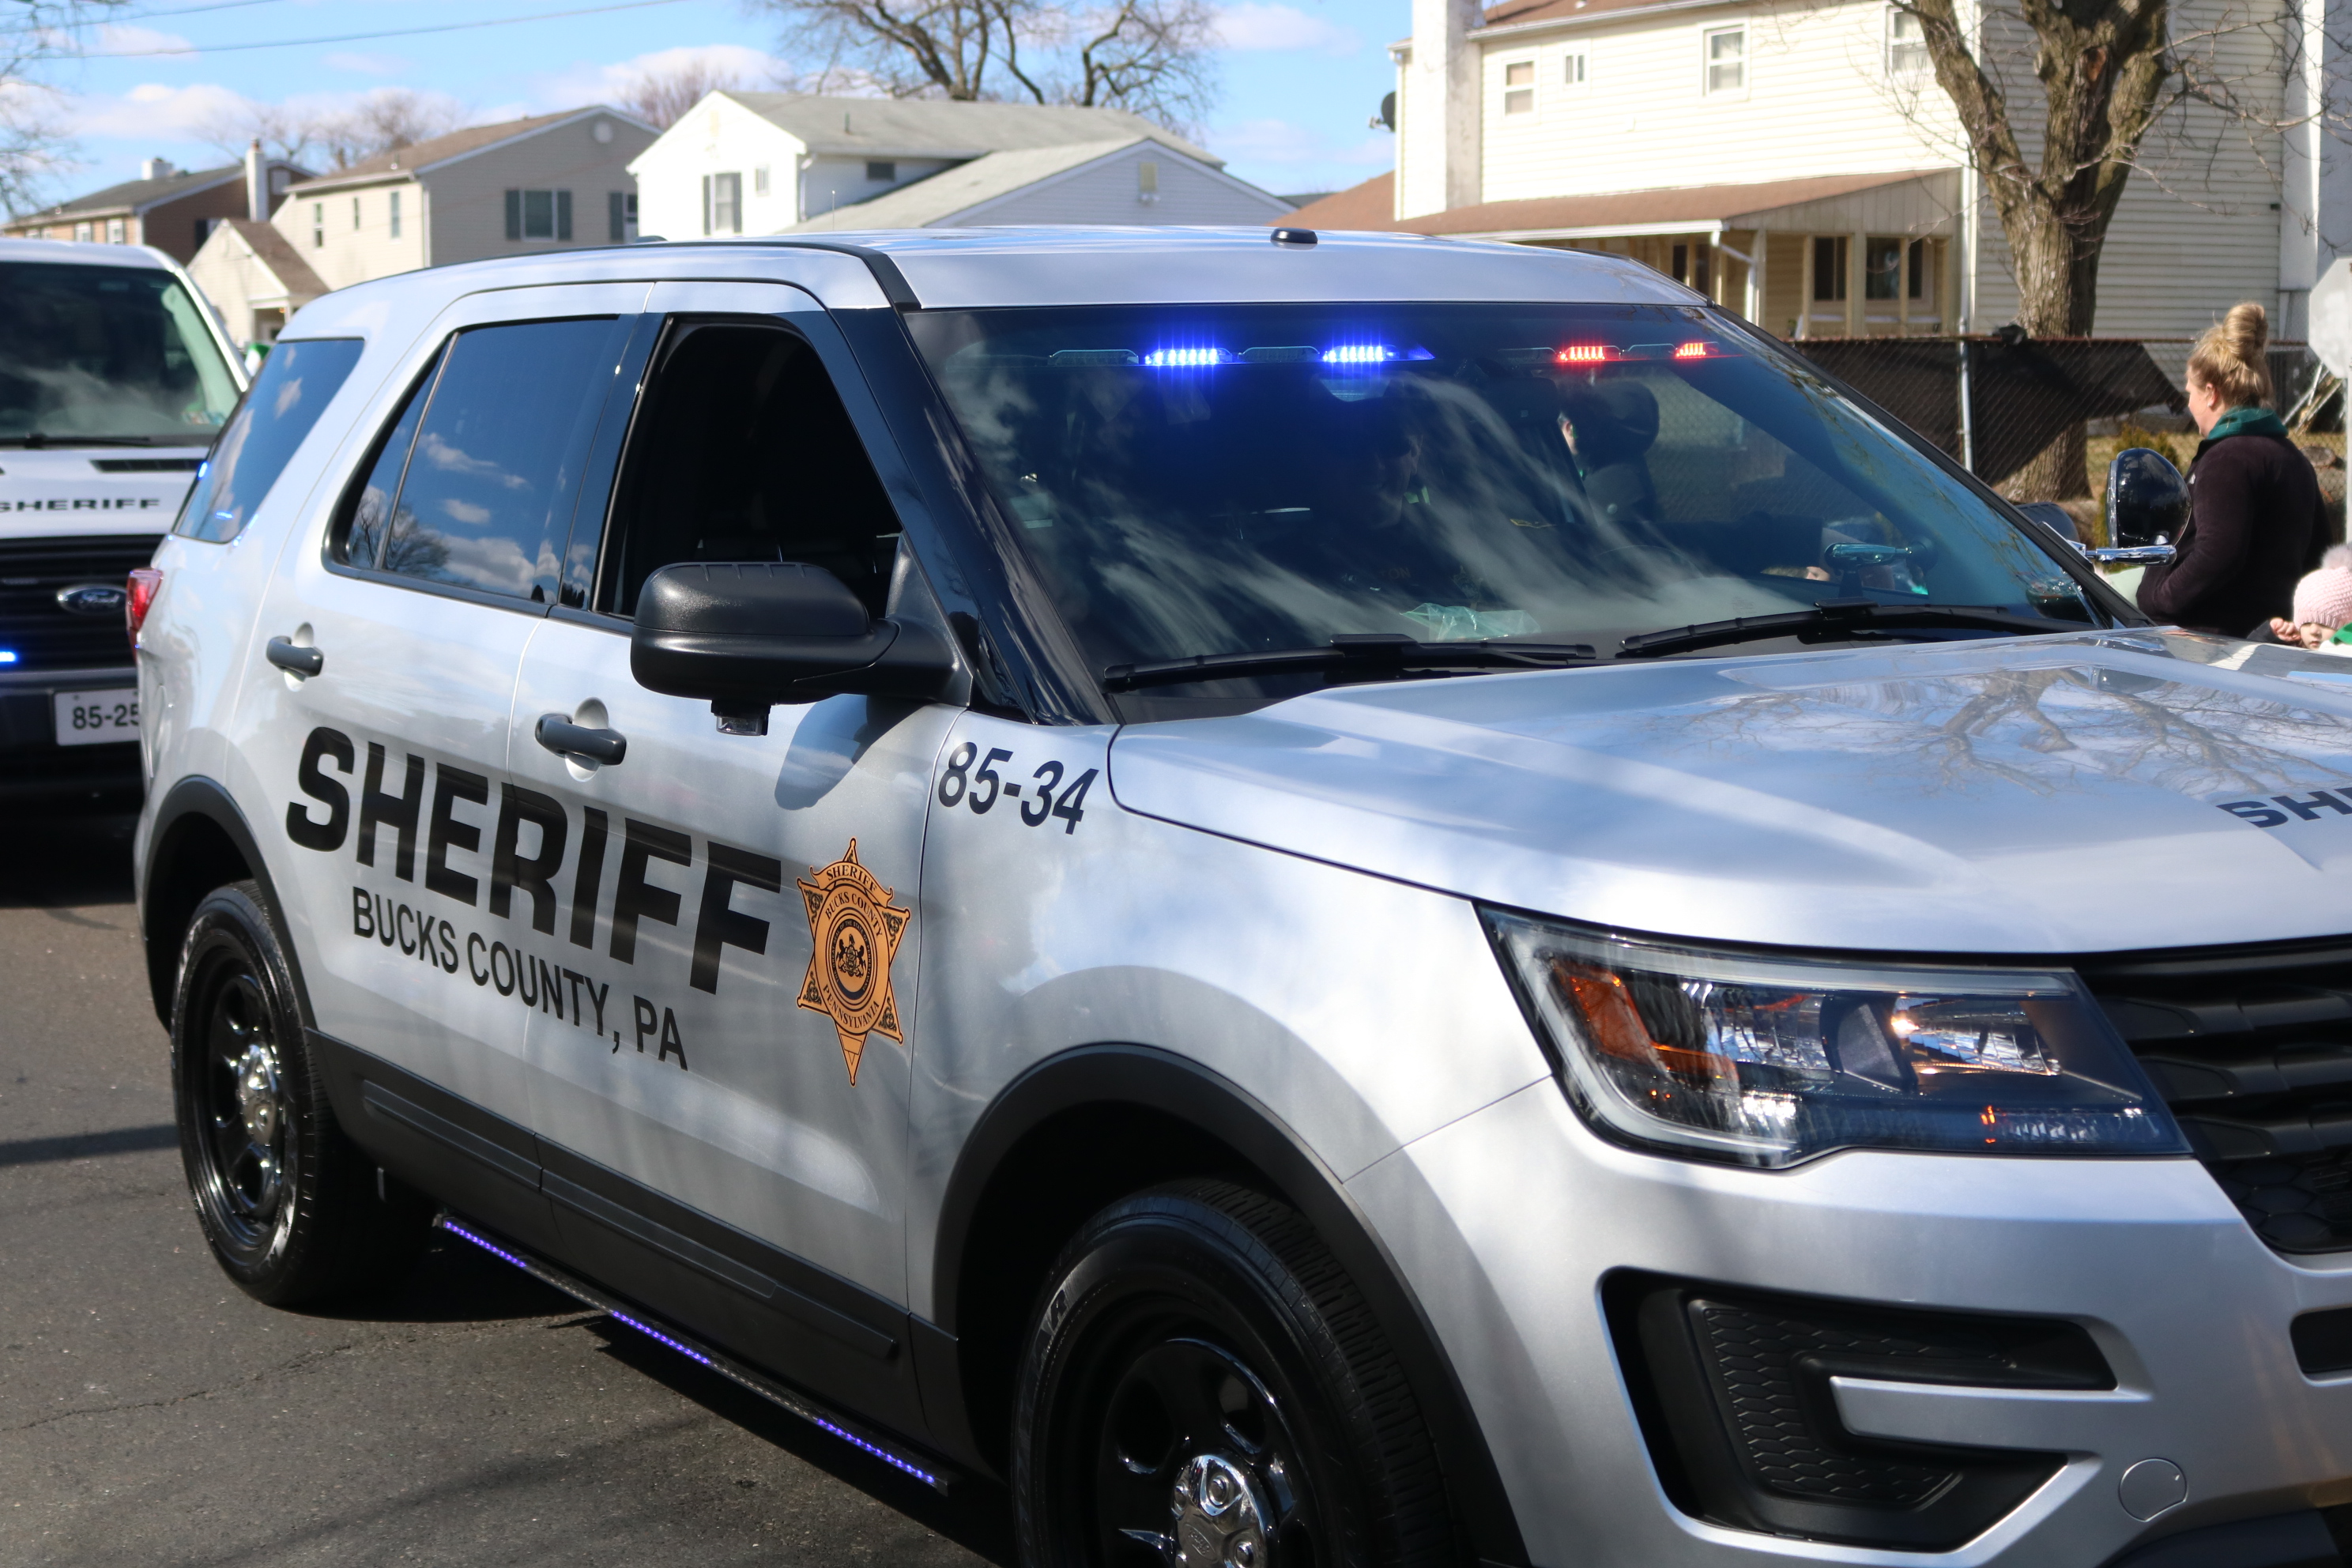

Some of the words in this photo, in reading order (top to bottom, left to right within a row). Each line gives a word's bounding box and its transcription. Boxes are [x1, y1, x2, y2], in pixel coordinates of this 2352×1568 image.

[73, 703, 138, 729] 85-25
[938, 741, 1099, 835] 85-34
[2215, 787, 2352, 828] SH
[286, 726, 782, 996] SHERIFF
[826, 865, 877, 892] SHERIFF
[825, 891, 850, 921] BUCKS
[852, 893, 883, 937] COUNTY
[352, 886, 459, 974] BUCKS
[467, 933, 620, 1054] COUNTY,
[633, 995, 688, 1072] PA
[823, 984, 880, 1028] PENNSYLVANIA
